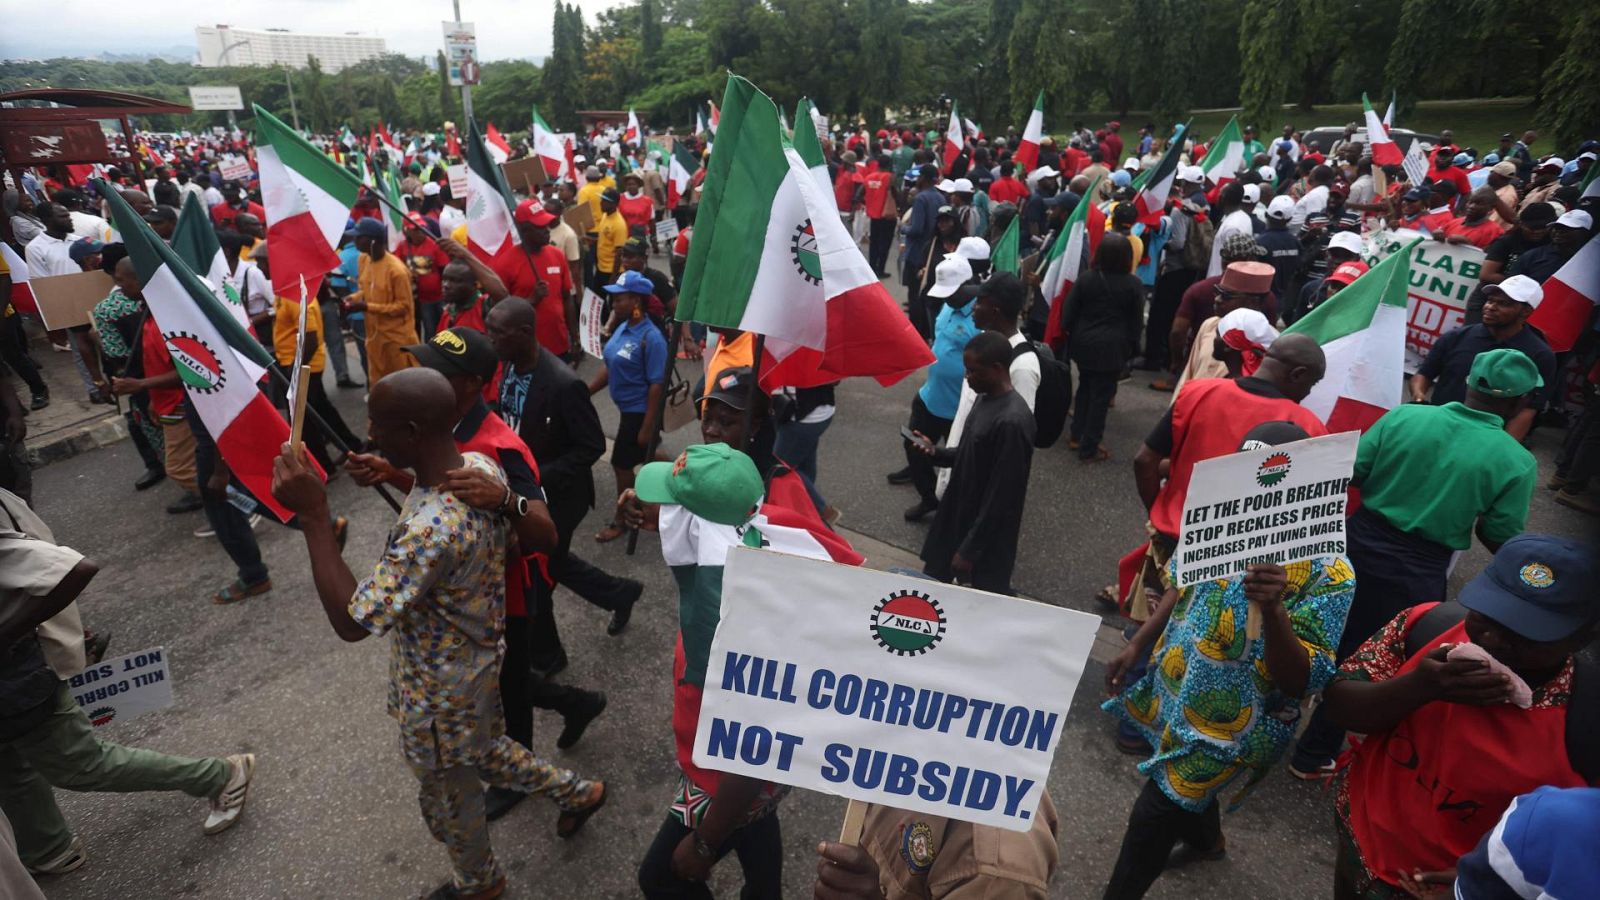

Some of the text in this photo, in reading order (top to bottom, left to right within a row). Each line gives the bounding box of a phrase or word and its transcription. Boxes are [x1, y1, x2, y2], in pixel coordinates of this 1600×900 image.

[1414, 248, 1482, 280] LAB
[179, 354, 204, 374] NLC
[1185, 505, 1211, 526] LET
[1214, 499, 1240, 520] THE
[1243, 490, 1283, 514] POOR
[1185, 500, 1344, 546] STOP RECKLESS PRICE
[1183, 520, 1343, 565] INCREASES PAY LIVING WAGE
[1181, 561, 1231, 585] SUPPORT
[1288, 540, 1345, 561] WORKERS
[895, 617, 922, 632] NLC
[69, 650, 162, 688] NOT SUB
[132, 669, 164, 688] KILL
[721, 651, 1059, 753] KILL CORRUPTION
[706, 717, 1035, 820] NOT SUBSIDY.
